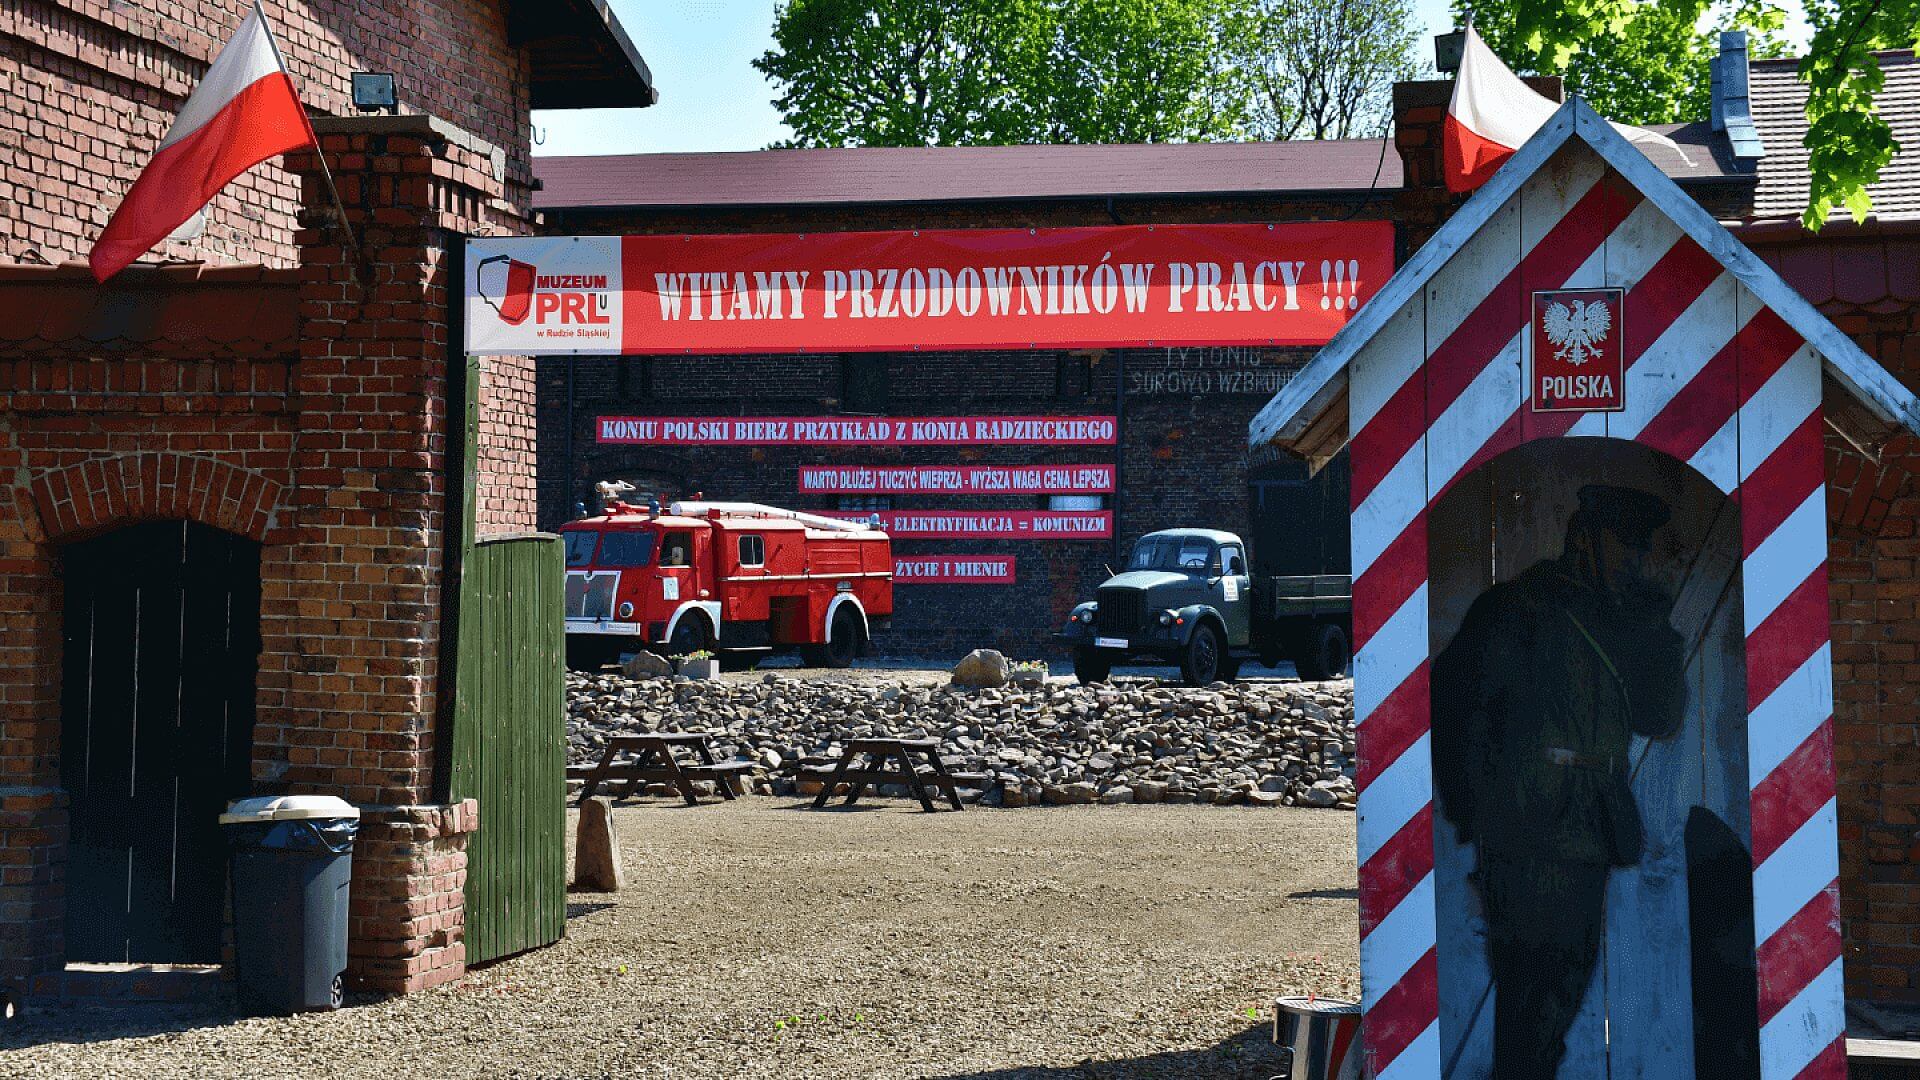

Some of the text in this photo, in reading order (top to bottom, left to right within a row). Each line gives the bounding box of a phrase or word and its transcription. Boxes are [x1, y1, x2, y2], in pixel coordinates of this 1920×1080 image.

[537, 275, 607, 288] MUZEUM
[655, 252, 1359, 320] WITAMY PRZODOWNIKÓW PRACY !!!
[547, 328, 573, 337] Rudzie
[1542, 376, 1613, 399] POLSKA
[602, 421, 1113, 440] KONIU POLSKI BIERZ PRZYKŁAD Z KONIA RADZIECKIEGO
[803, 471, 837, 489] WARTO
[840, 467, 876, 489] DŁUŻEJ
[879, 468, 917, 489] TUCZYĆ
[919, 470, 962, 489] WIEPRZA
[971, 467, 1010, 489] WYŻSZA
[1013, 470, 1041, 489] WAGA
[1044, 470, 1071, 489] CENA
[1073, 470, 1110, 489] LEPSZA
[894, 516, 1013, 532] ELEKTRYFIKACJA
[1032, 517, 1105, 532] KOMUNIZM
[895, 560, 1008, 577] ŻYCIE I MIENIE
